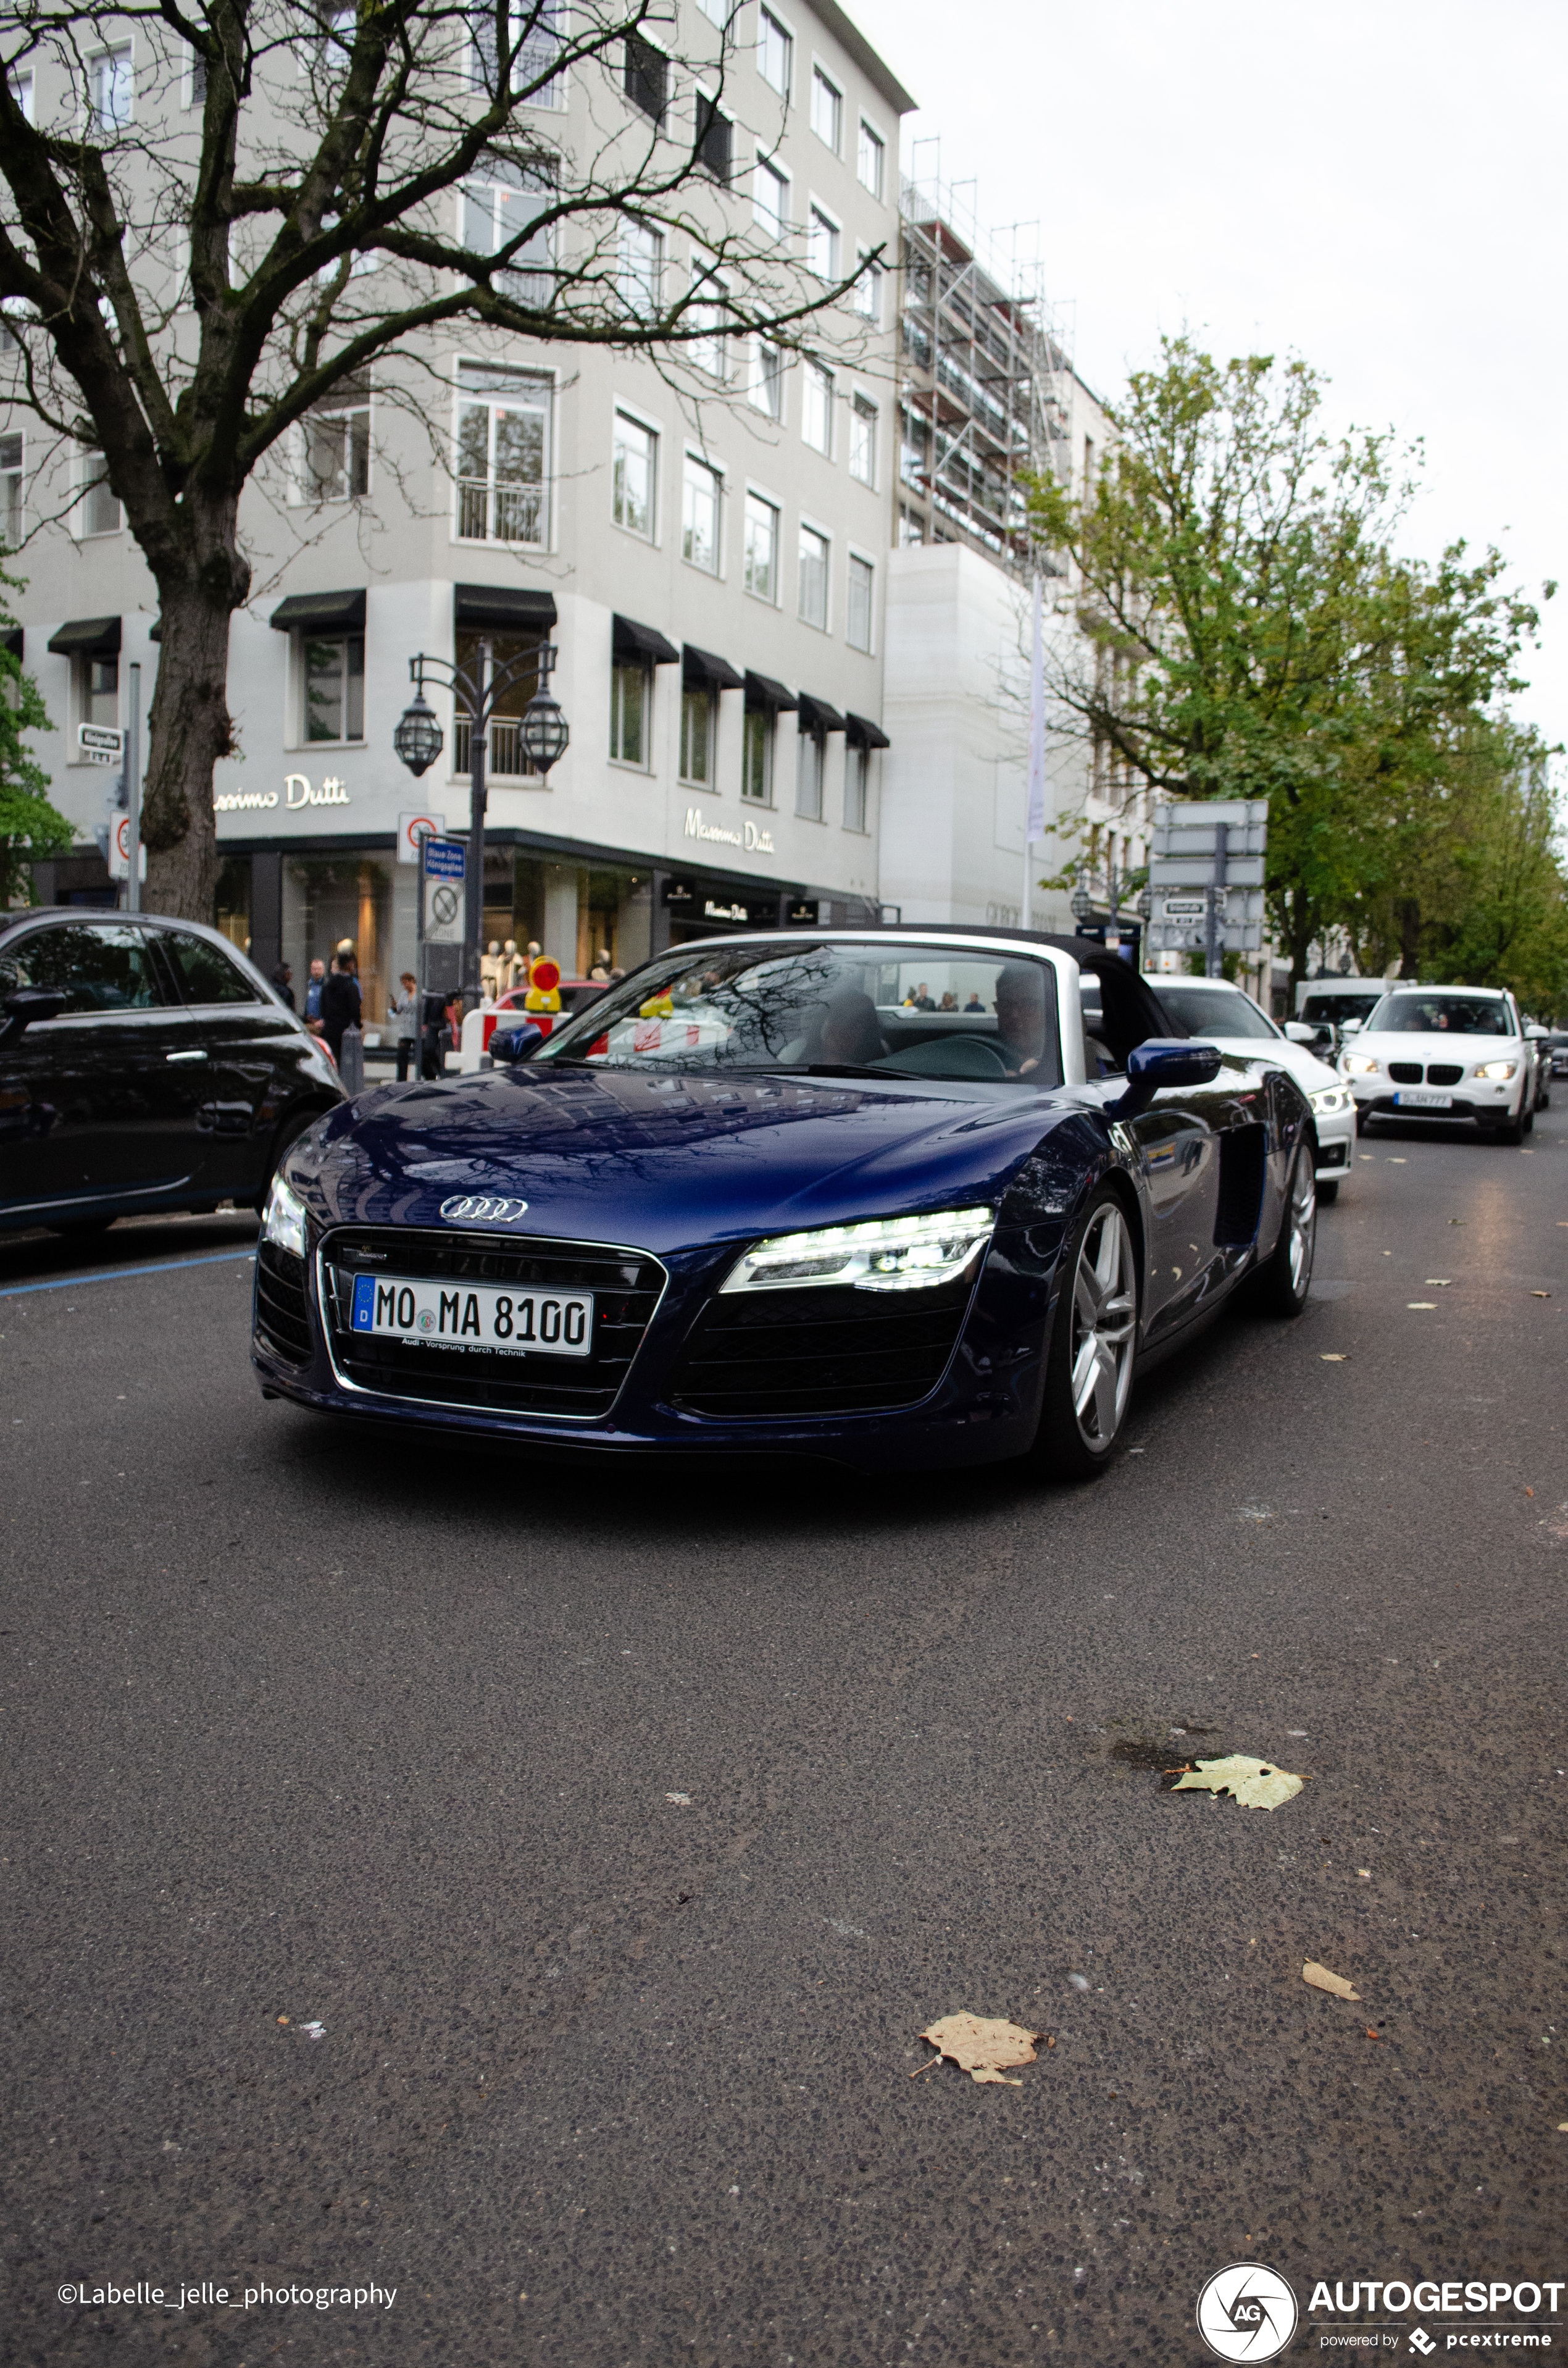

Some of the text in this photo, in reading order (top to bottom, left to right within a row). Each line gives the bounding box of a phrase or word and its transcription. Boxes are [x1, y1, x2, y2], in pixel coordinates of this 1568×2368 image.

[213, 774, 351, 811] ssimo Dutti
[685, 807, 775, 854] Massimo Dutti
[360, 1310, 368, 1322] D
[376, 1285, 415, 1328] MO
[439, 1291, 480, 1336] MA
[494, 1296, 585, 1345] 8100
[402, 1337, 419, 1346] Audi
[426, 1341, 465, 1352] Vorsprung
[469, 1345, 491, 1354] durch
[494, 1347, 525, 1357] Technik
